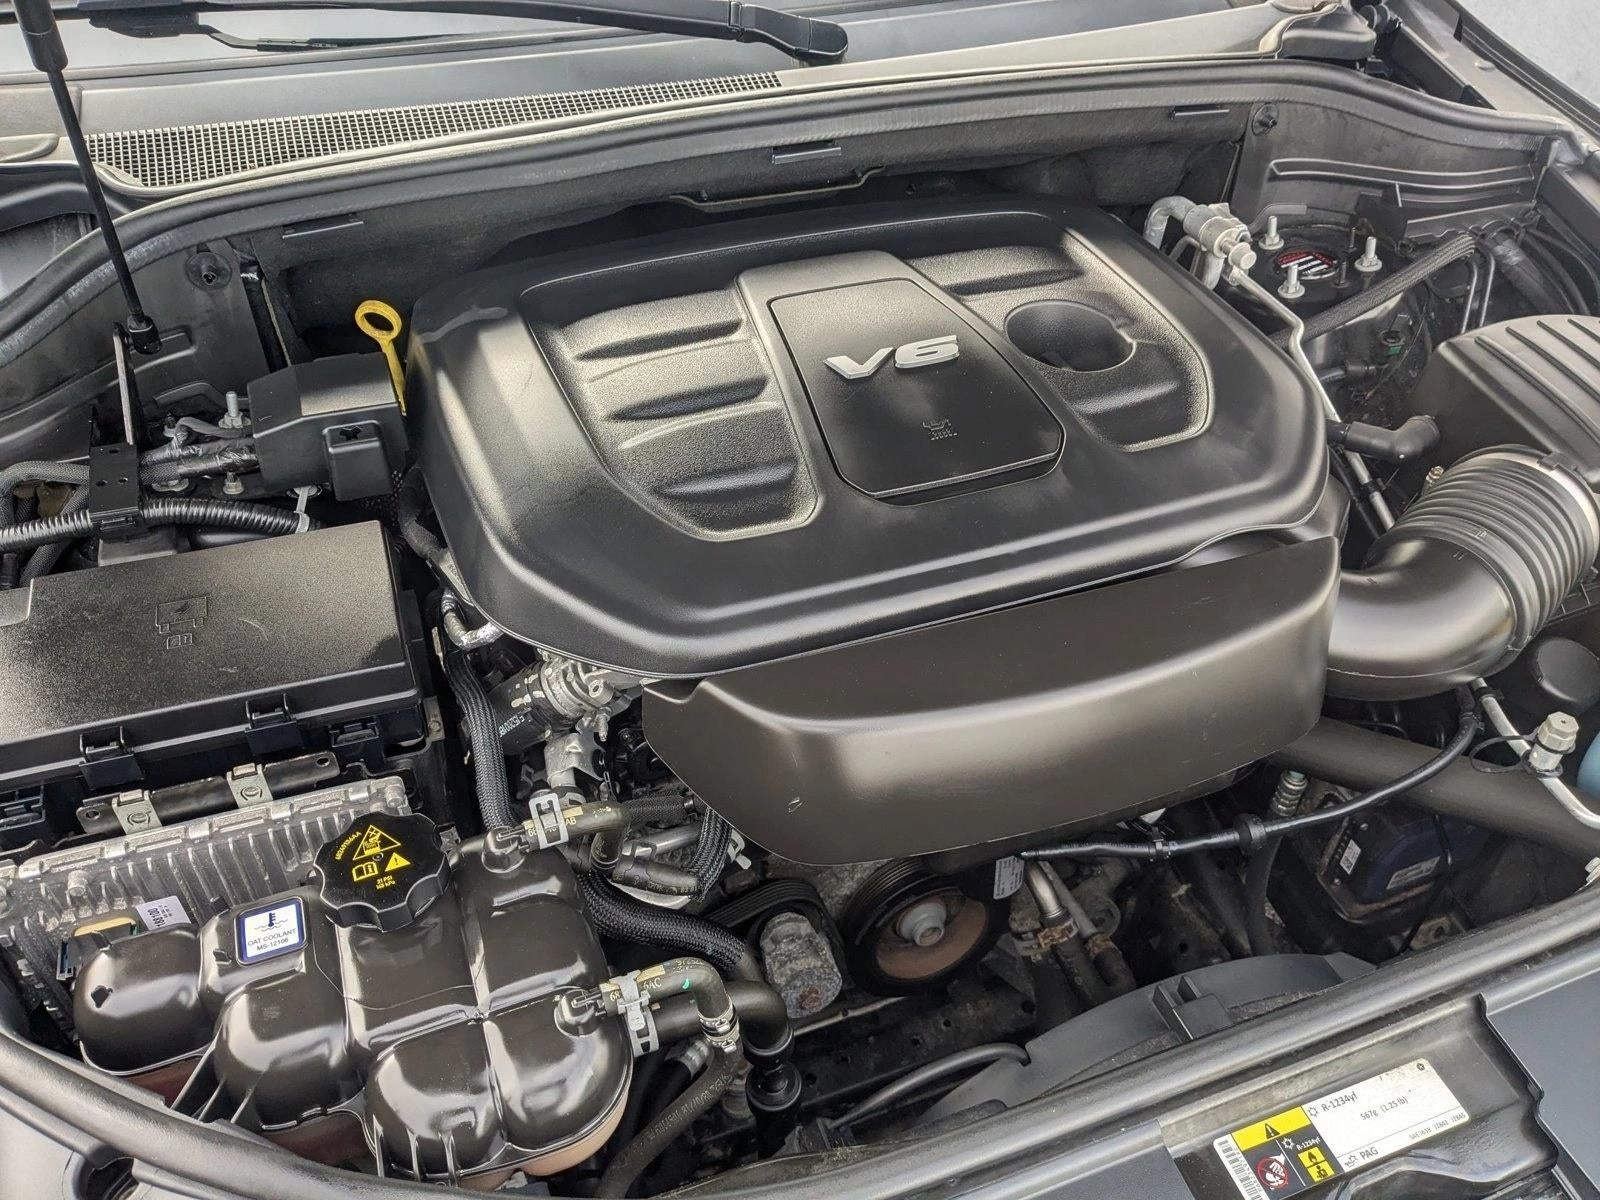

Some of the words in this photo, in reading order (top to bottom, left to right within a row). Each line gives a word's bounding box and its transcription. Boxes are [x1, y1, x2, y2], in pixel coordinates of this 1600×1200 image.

[822, 334, 960, 380] V6
[247, 937, 262, 946] OAT
[262, 928, 297, 942] COOLANT
[256, 937, 289, 951] MS-12106
[1321, 1091, 1358, 1112] R-1234yf
[1360, 1109, 1379, 1120] 567g
[1296, 1136, 1320, 1150] R-1234yf
[1360, 1146, 1379, 1160] PAG
